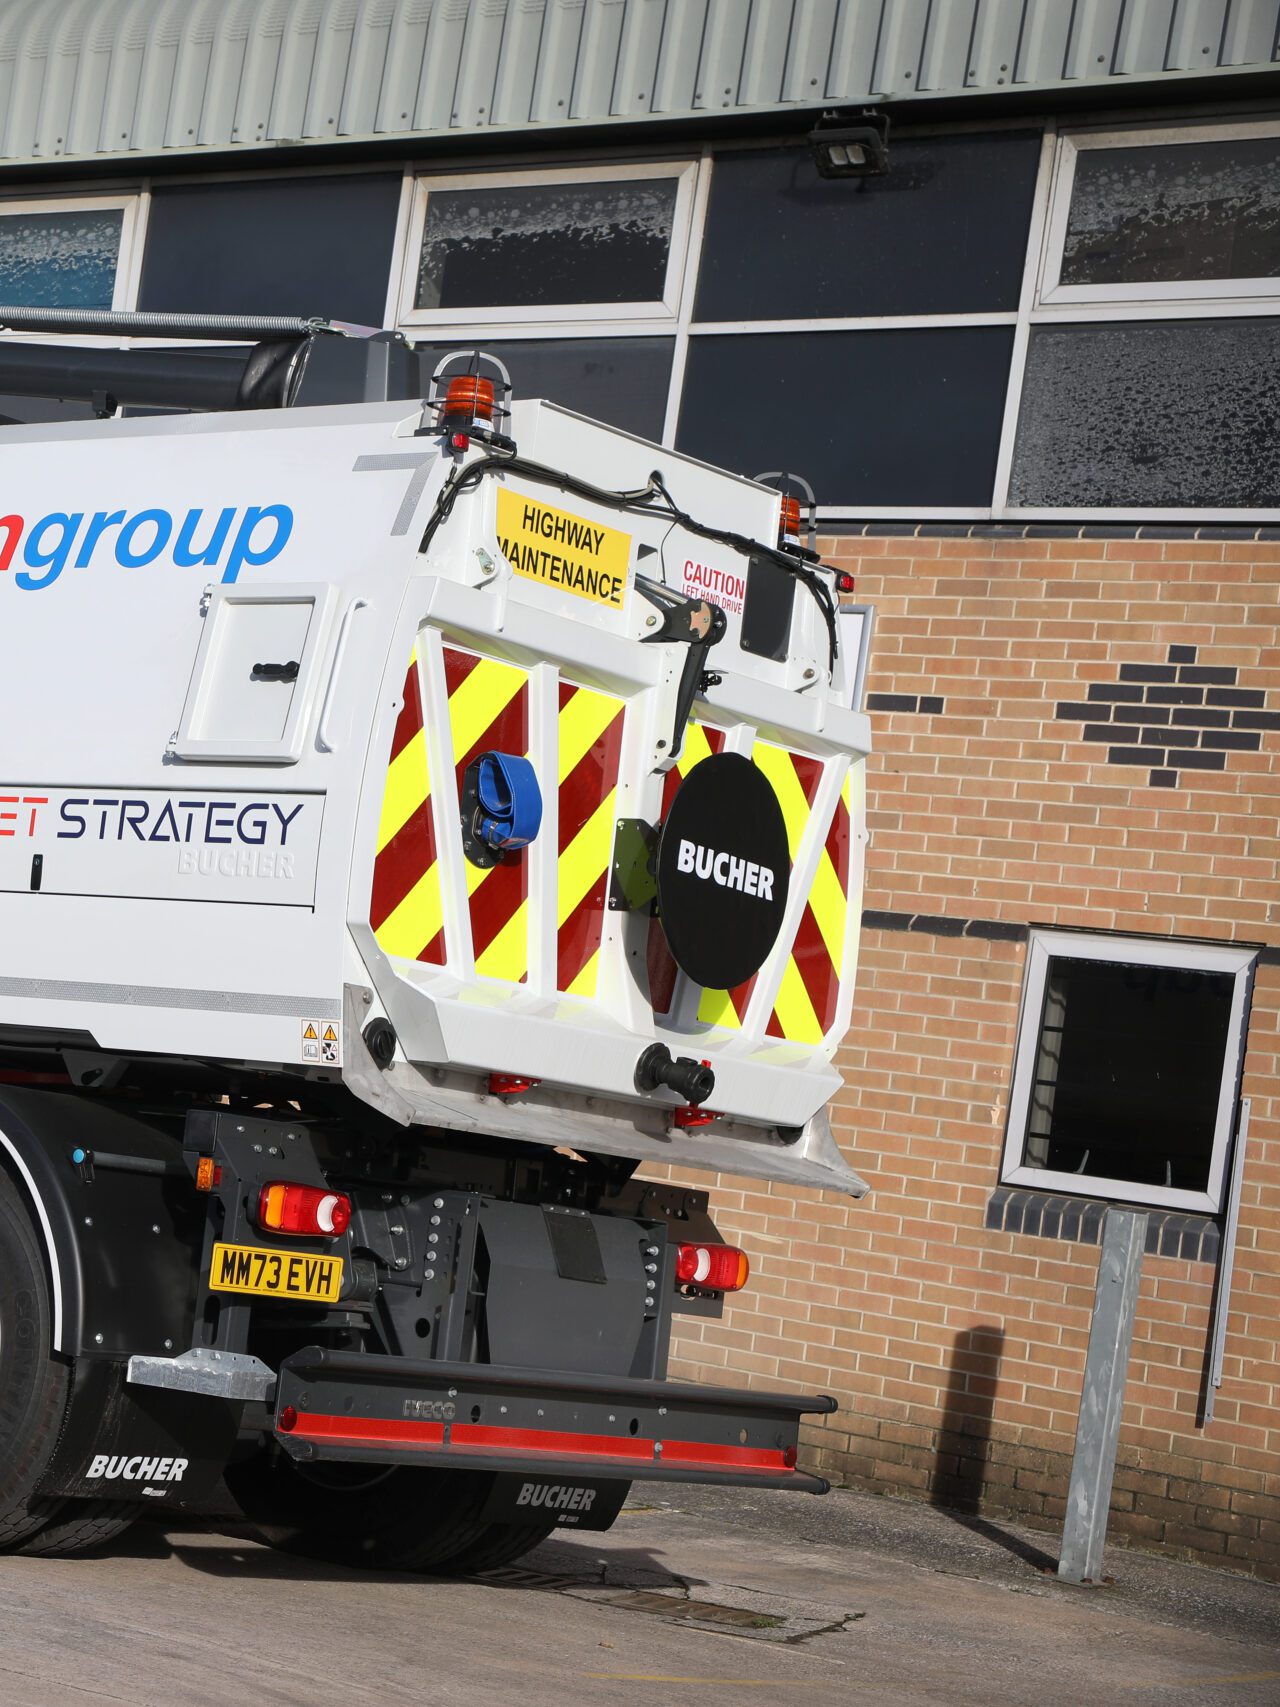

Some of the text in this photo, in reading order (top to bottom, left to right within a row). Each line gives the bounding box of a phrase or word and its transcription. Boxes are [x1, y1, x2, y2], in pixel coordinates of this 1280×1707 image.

[522, 504, 606, 556] HIGHWAY
[496, 535, 623, 604] MAINTENANCE
[683, 560, 745, 600] CAUTION
[682, 583, 742, 615] LEFT HAND DRIVE
[57, 798, 305, 846] STRATEGY
[178, 848, 295, 879] BUCHER
[677, 839, 775, 901] BUCHER
[220, 1249, 333, 1295] MM73 EVH
[403, 1399, 456, 1420] IVECO
[85, 1454, 189, 1481] BUCHER
[516, 1483, 596, 1511] BUCHER
